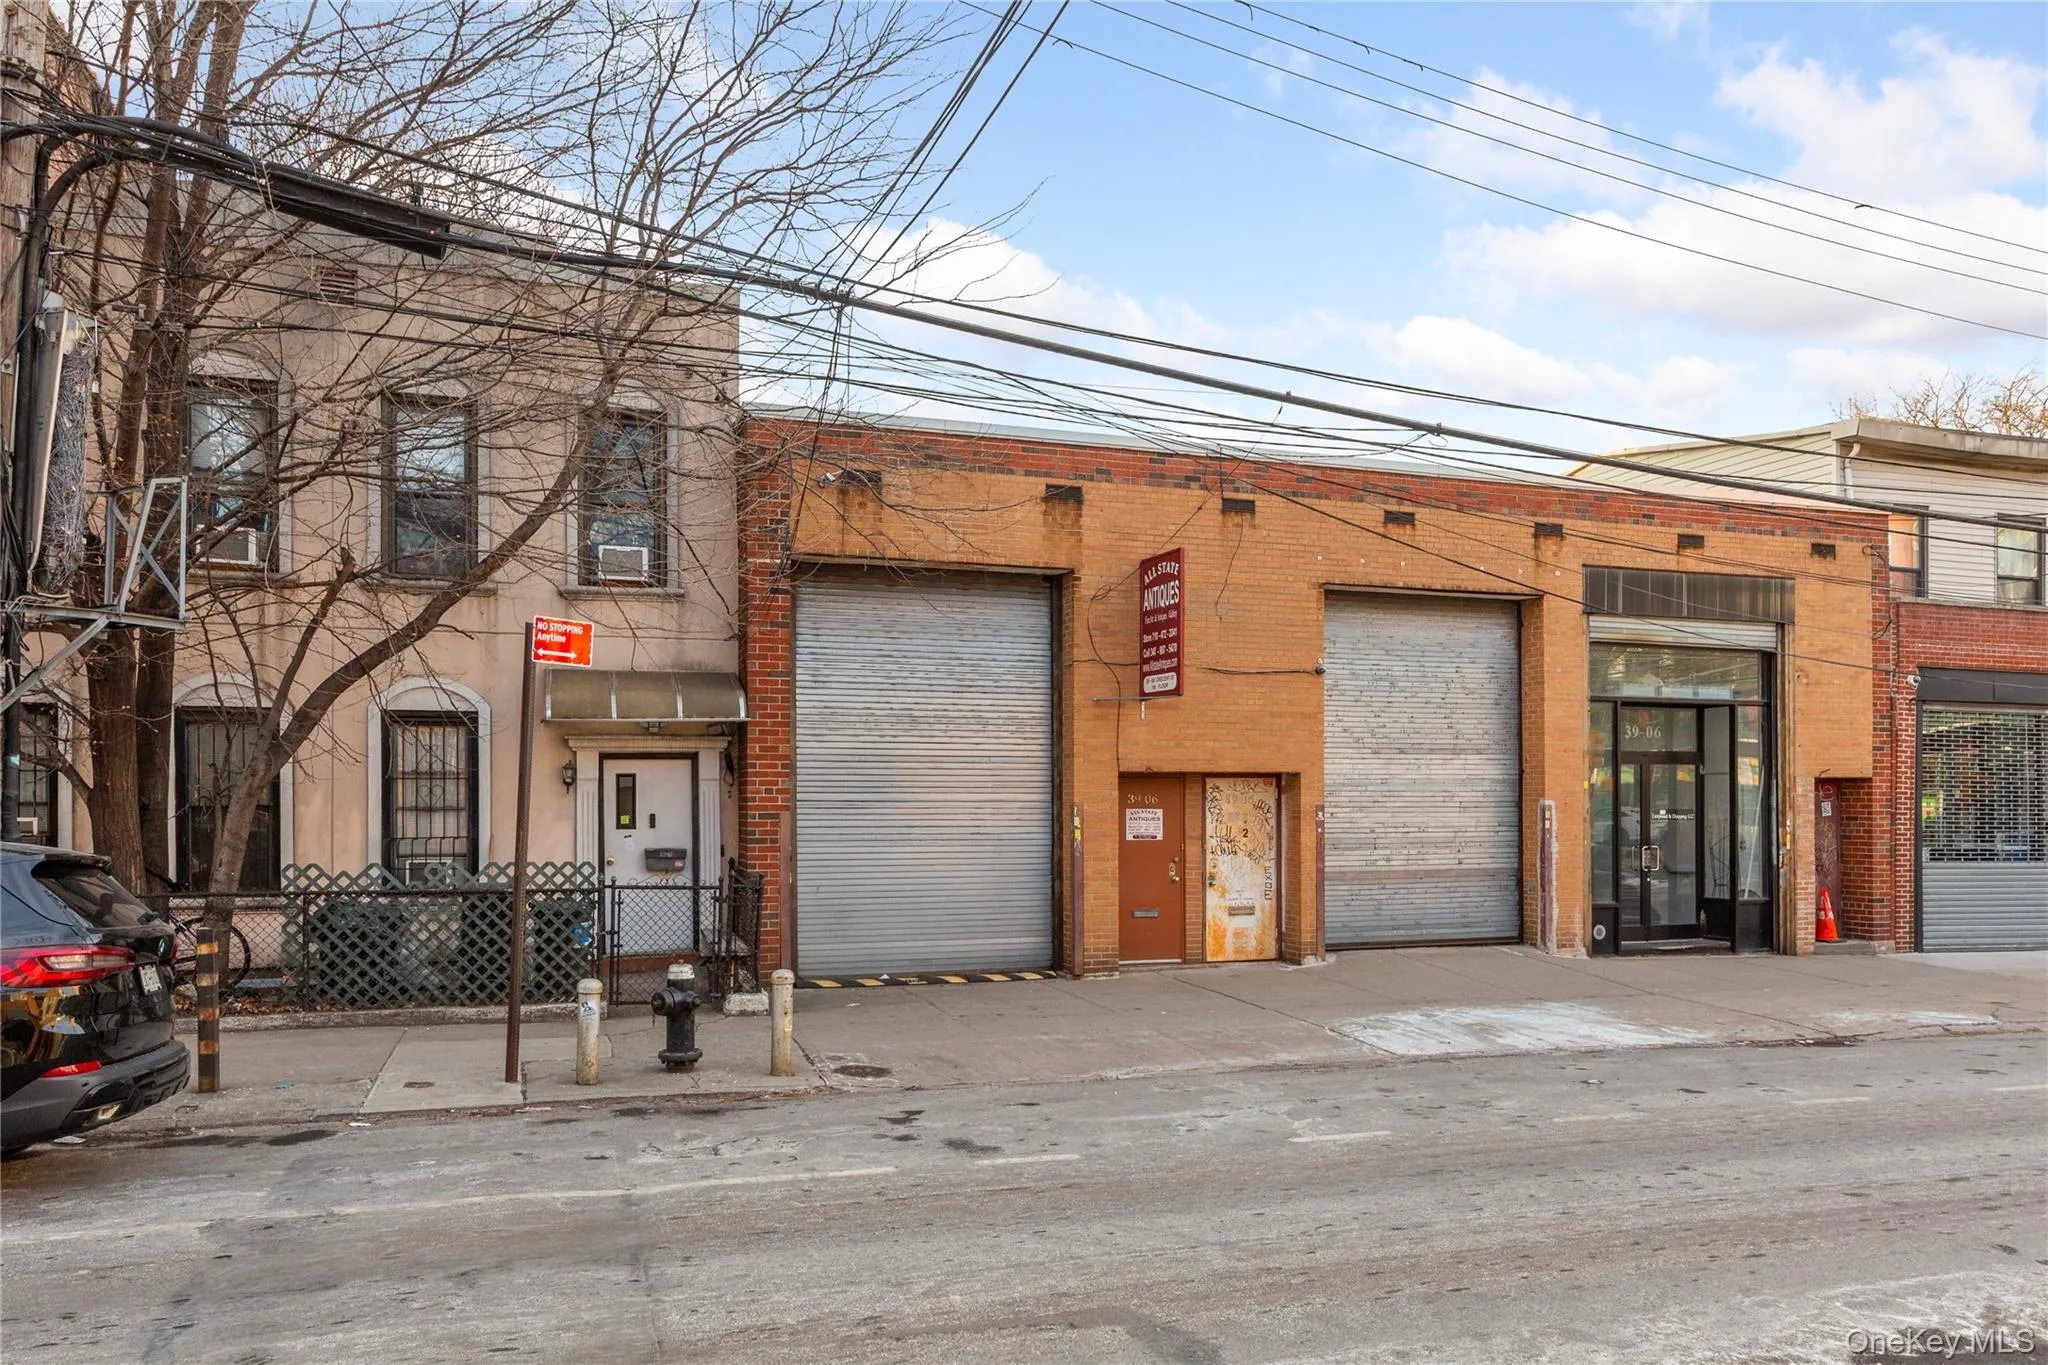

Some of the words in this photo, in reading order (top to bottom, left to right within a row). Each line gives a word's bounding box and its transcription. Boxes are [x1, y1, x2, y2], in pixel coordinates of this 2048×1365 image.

[1144, 567, 1157, 586] ALL
[1157, 561, 1180, 576] STATE
[1143, 579, 1180, 612] ANTIQUES
[537, 621, 548, 631] NO
[549, 622, 583, 634] STOPPING
[537, 632, 567, 643] Anytime
[1624, 724, 1662, 739] 39-06
[1242, 828, 1249, 838] 2
